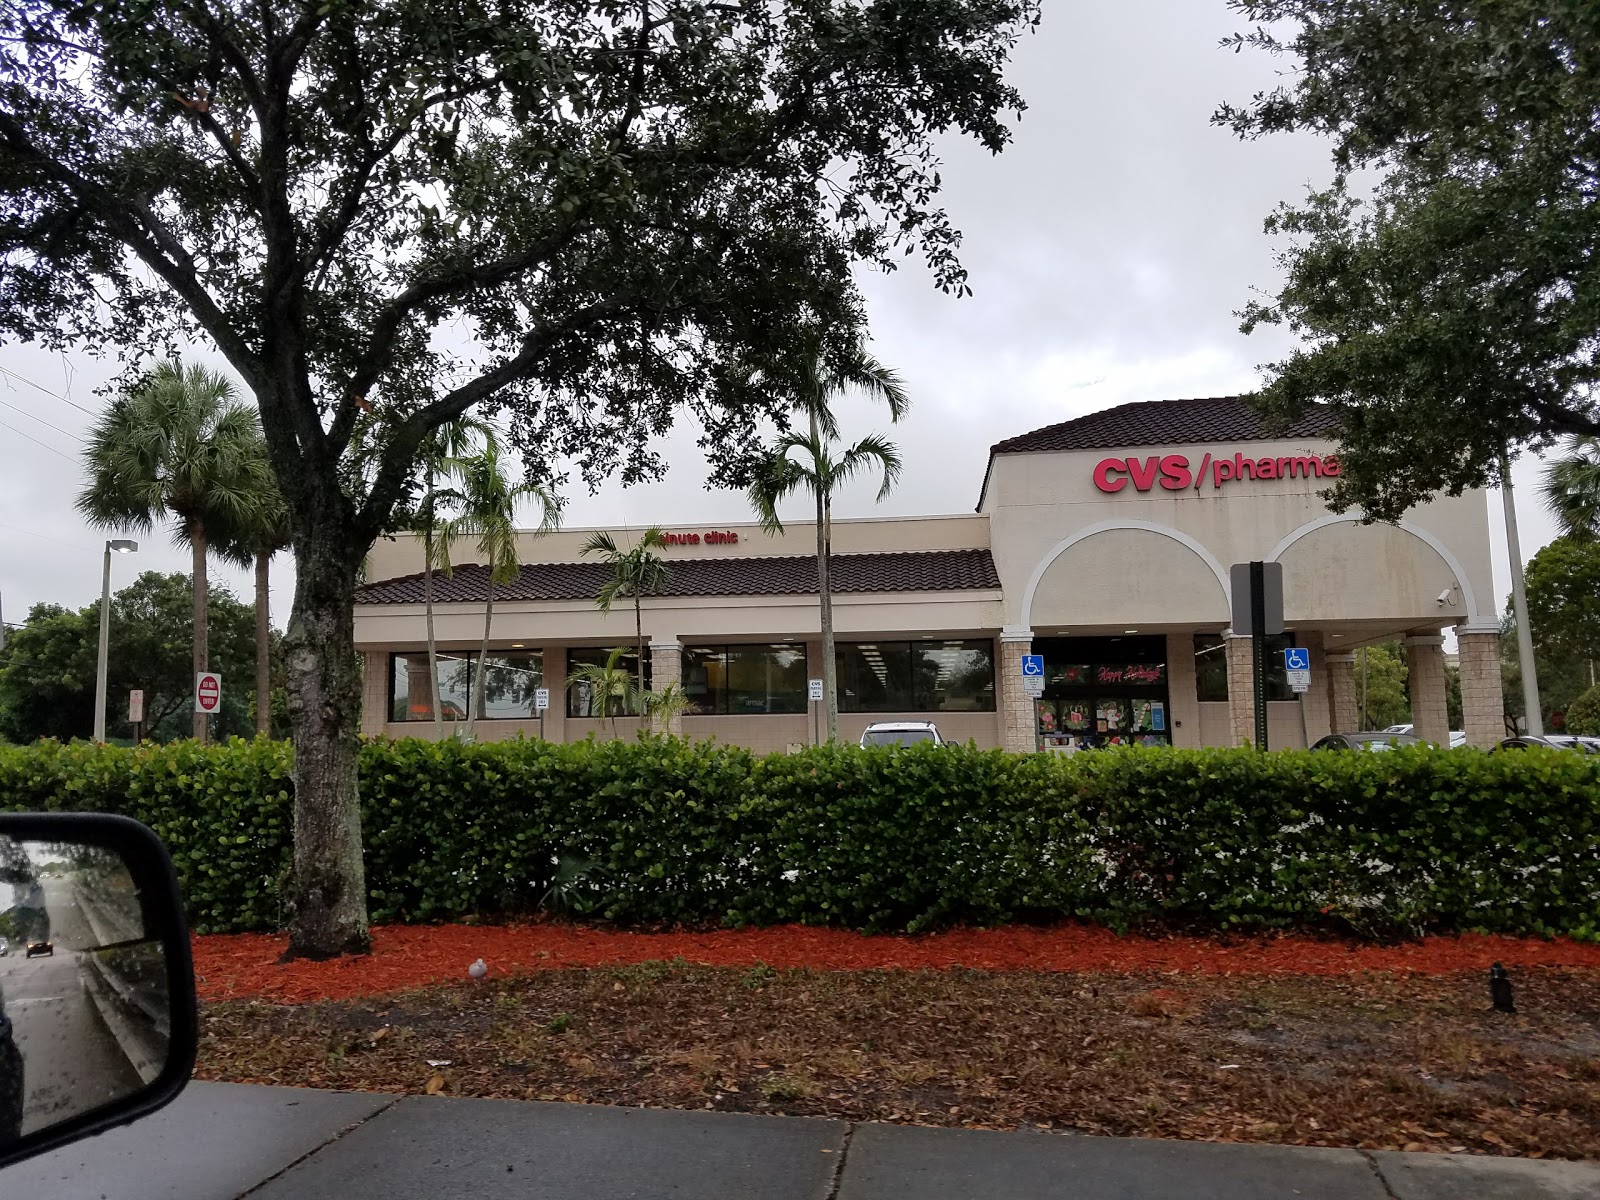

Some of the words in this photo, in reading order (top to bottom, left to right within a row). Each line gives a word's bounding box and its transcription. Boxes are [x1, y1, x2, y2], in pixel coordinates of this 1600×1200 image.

[1093, 452, 1342, 492] CVS/pharma
[646, 531, 701, 545] inute
[703, 530, 739, 545] clinic
[1097, 665, 1122, 682] Happy
